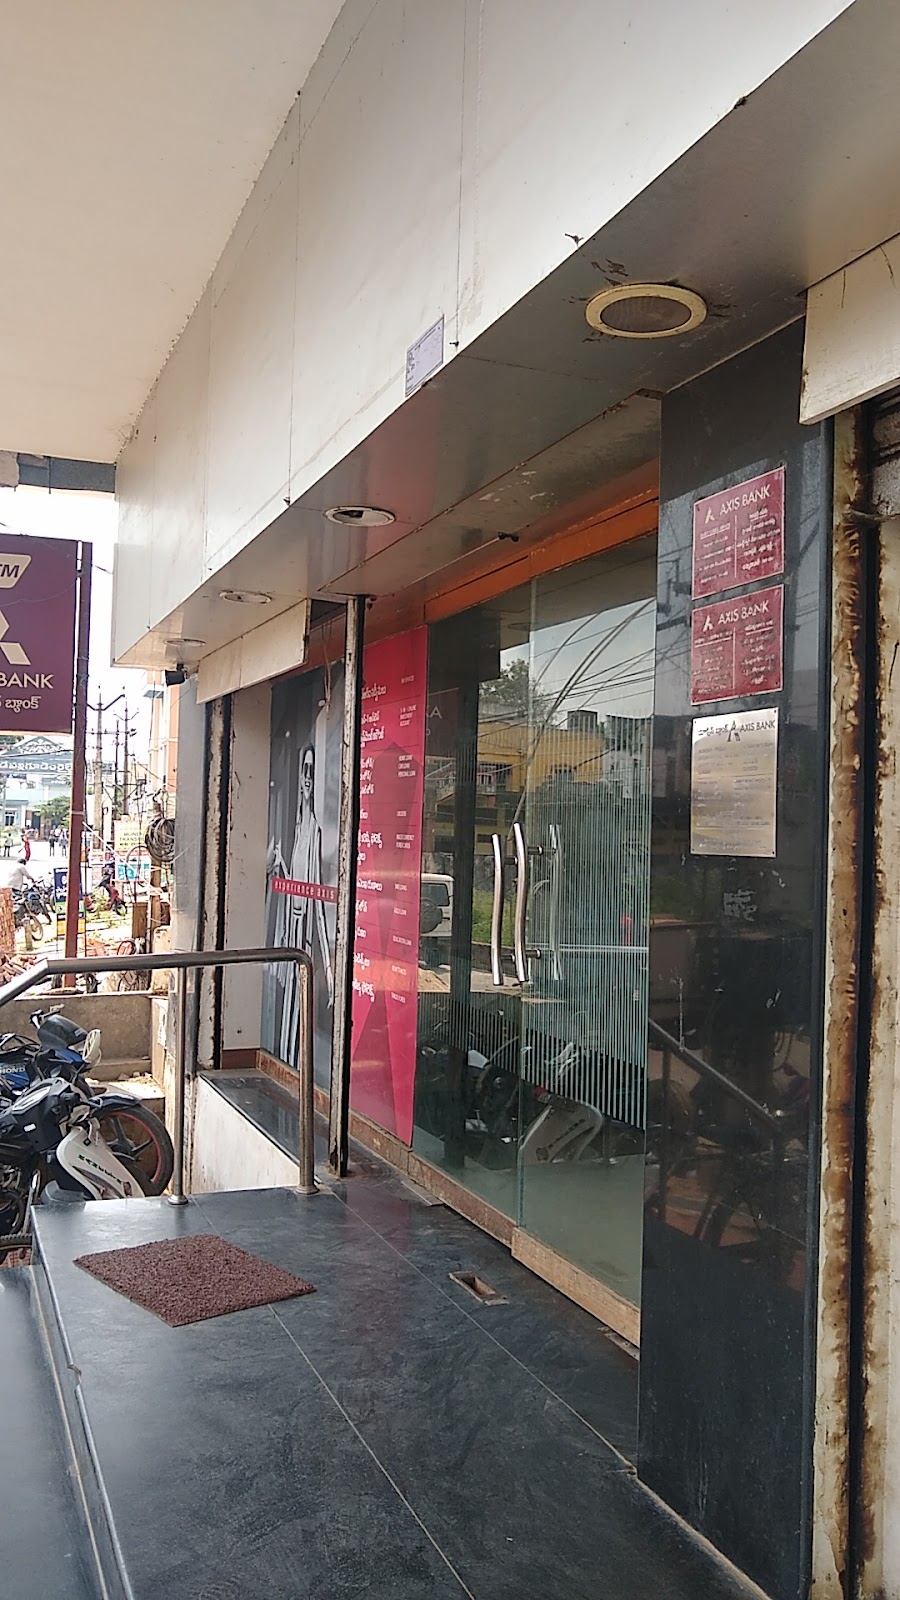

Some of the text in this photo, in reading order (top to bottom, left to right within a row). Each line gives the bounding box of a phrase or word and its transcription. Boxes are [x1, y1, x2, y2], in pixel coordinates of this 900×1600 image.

[719, 484, 771, 516] AXIS BANK
[0, 563, 20, 578] M
[717, 600, 770, 626] AXIS BANK
[0, 672, 55, 689] BANK
[739, 719, 776, 733] AXIS BANK
[273, 880, 335, 900] experience axis
